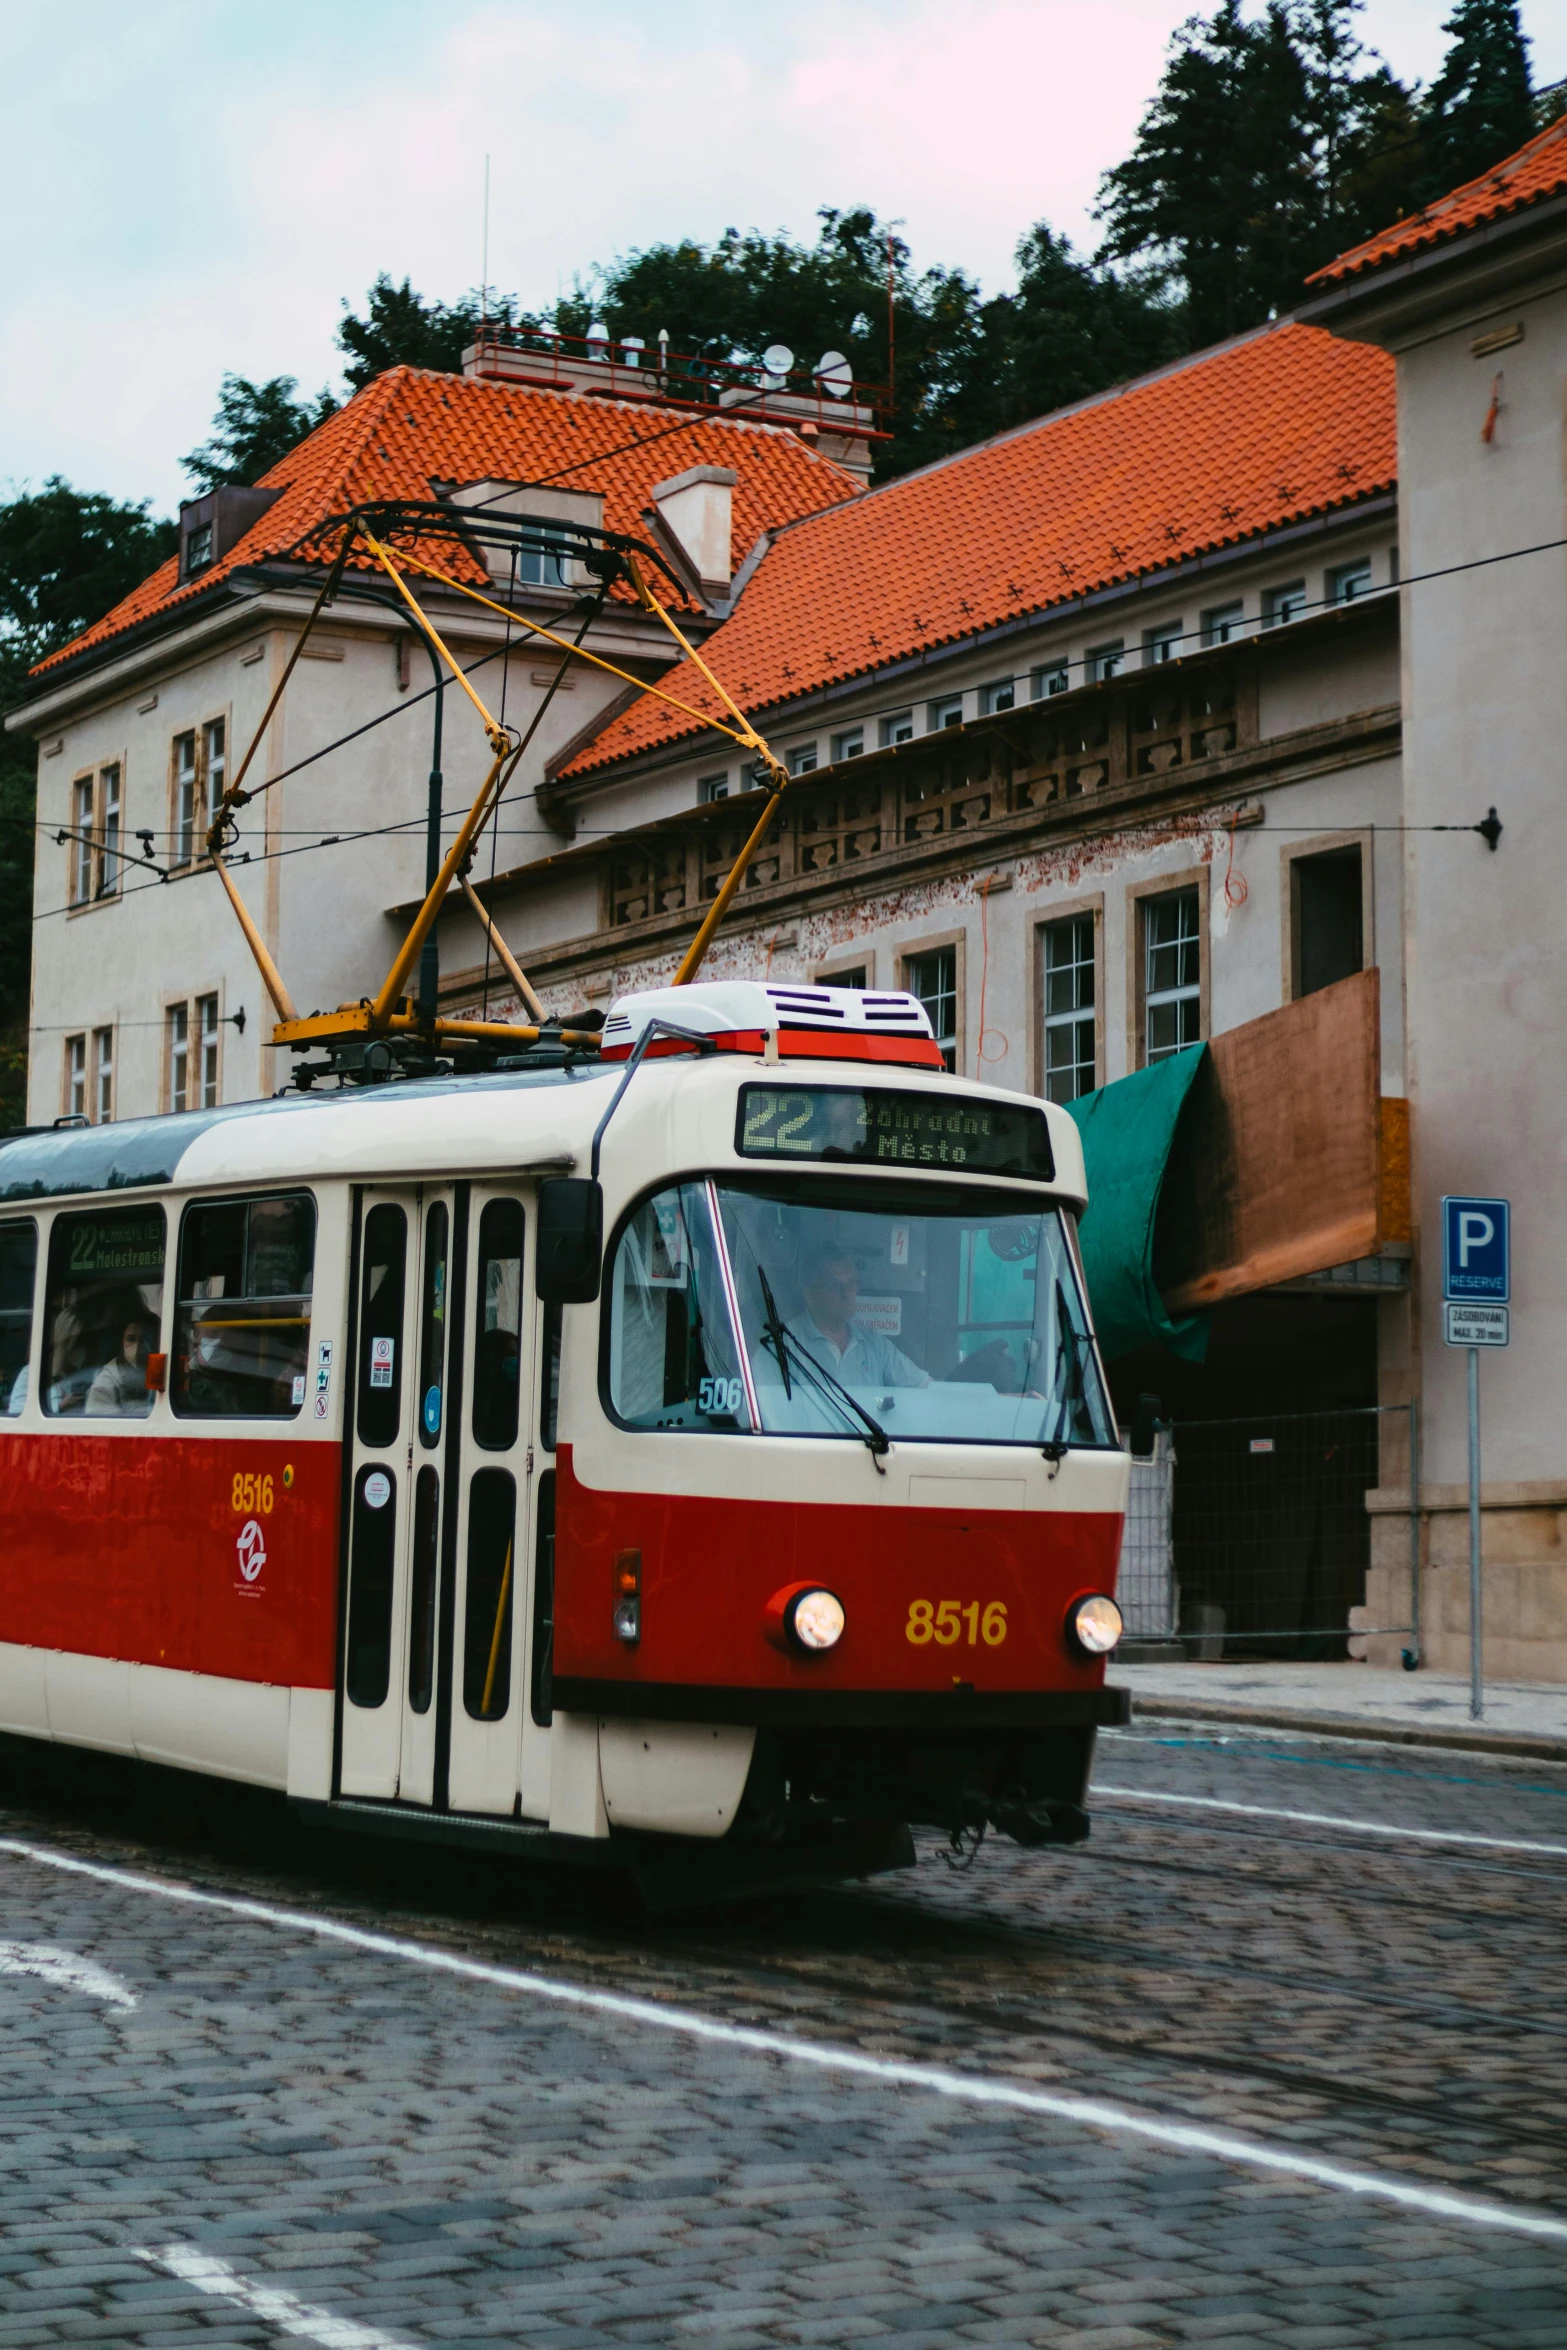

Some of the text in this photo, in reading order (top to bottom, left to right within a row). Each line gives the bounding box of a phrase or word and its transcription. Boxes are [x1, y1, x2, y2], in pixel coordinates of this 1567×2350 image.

[743, 1091, 814, 1151] 22
[878, 1134, 967, 1163] Město
[70, 1225, 97, 1270] 22
[1459, 1211, 1494, 1268] P
[1476, 1328, 1486, 1339] 20
[698, 1377, 743, 1410] 506
[231, 1472, 274, 1514] 8516
[905, 1599, 1008, 1646] 8516
